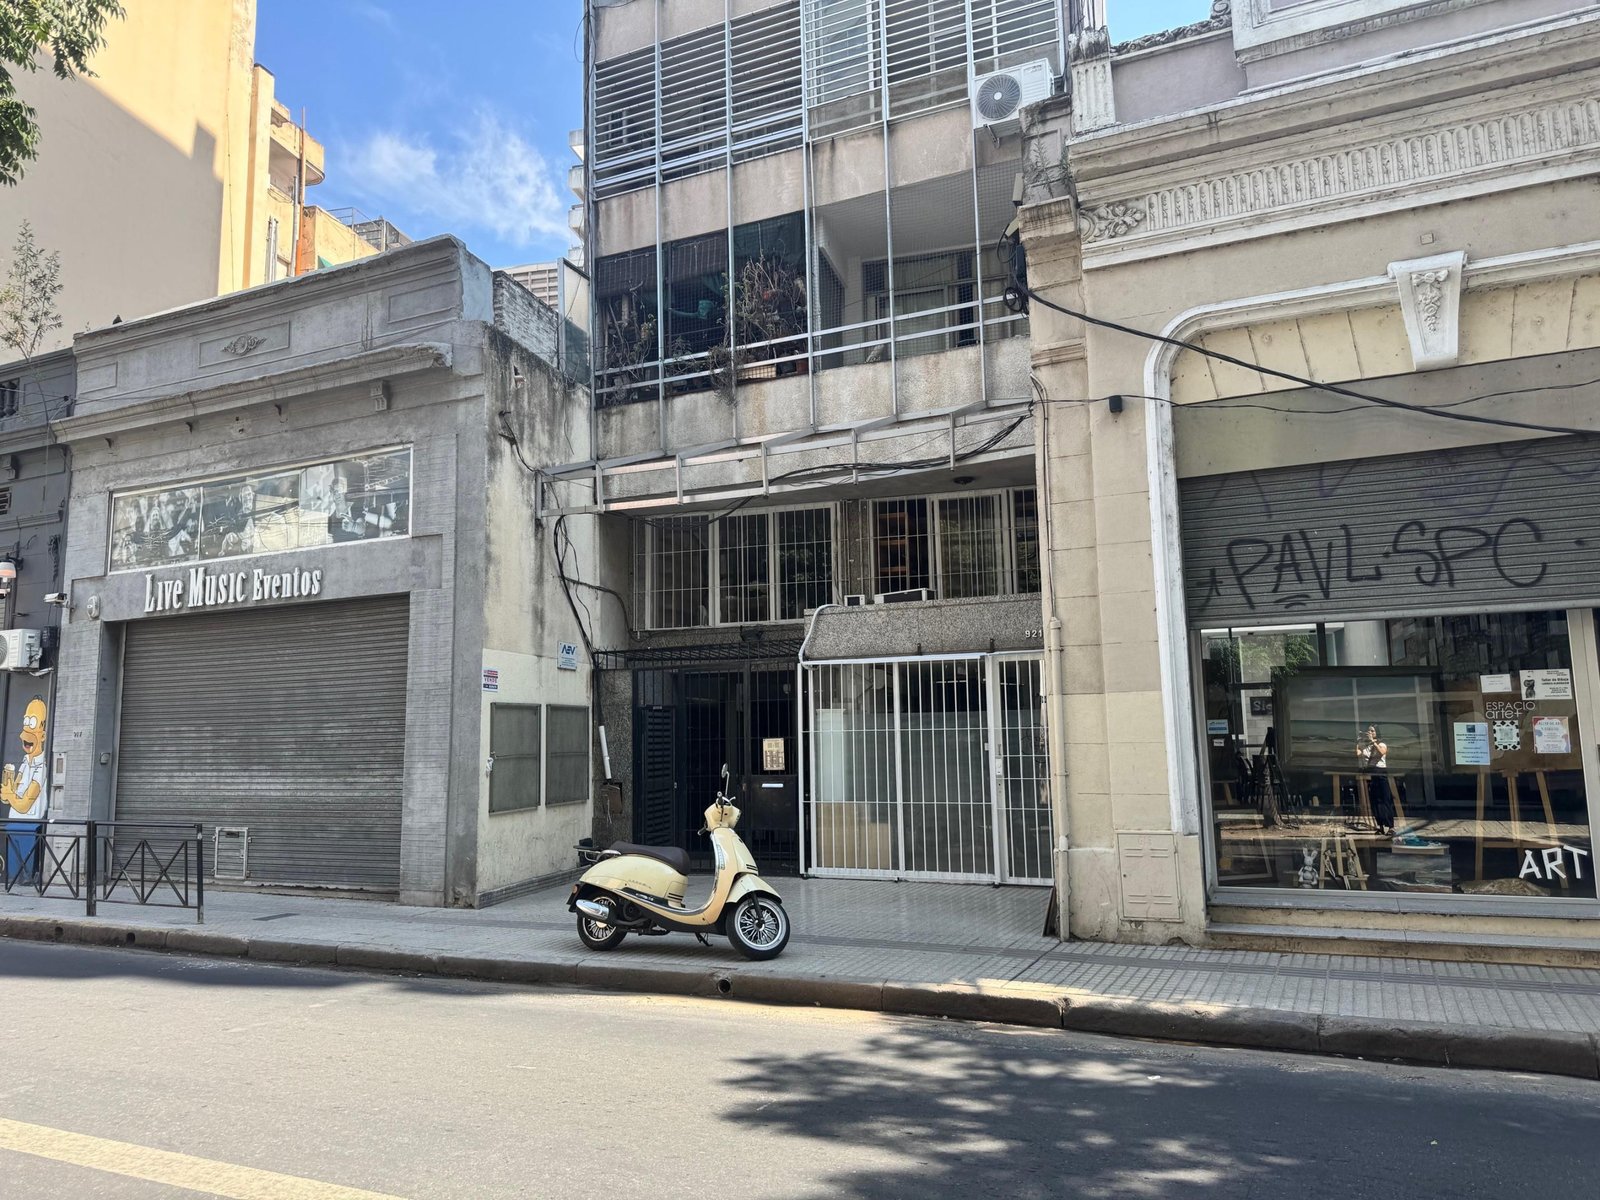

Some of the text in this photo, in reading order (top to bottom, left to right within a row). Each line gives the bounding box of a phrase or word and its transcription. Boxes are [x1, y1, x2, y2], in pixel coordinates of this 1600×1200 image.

[144, 567, 322, 613] Live Music Eventos
[1024, 629, 1043, 638] 921
[1485, 701, 1536, 711] ESPACIO
[1518, 844, 1588, 880] ART
